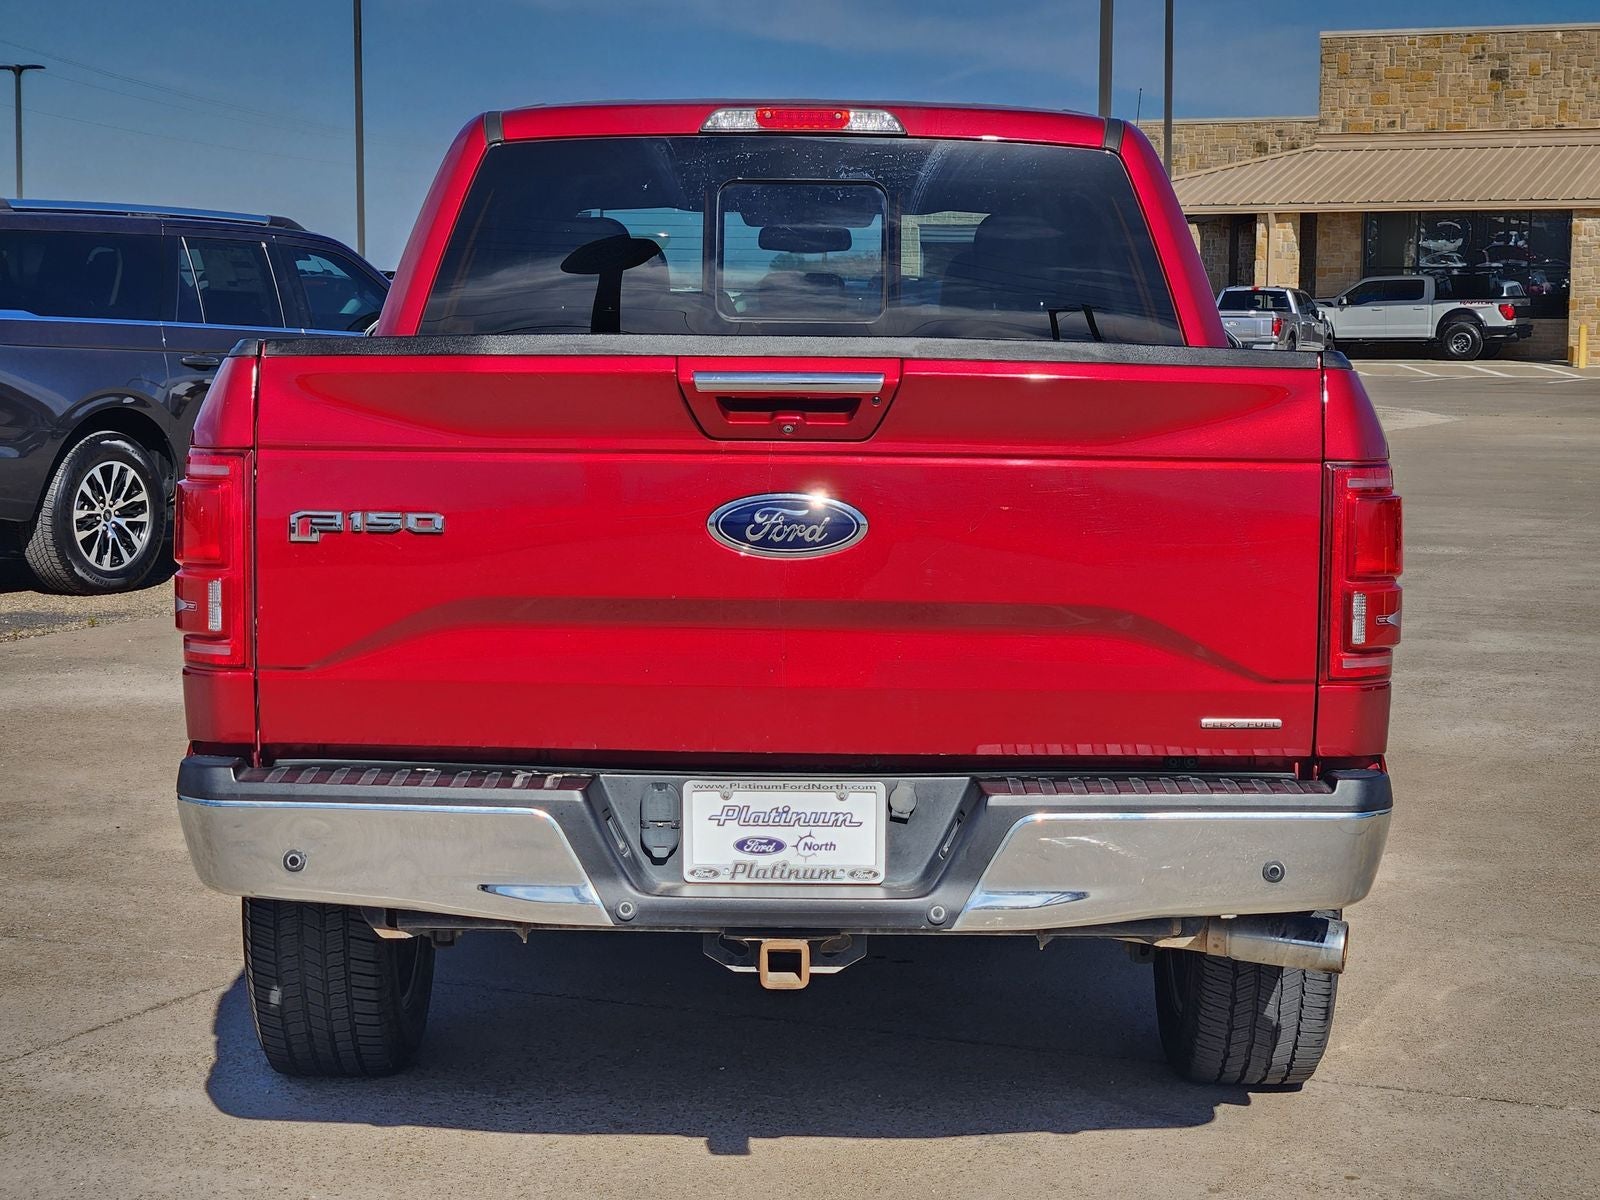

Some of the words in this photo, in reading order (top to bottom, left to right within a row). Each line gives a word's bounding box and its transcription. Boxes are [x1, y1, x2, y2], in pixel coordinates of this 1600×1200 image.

[745, 506, 830, 543] Ford
[1246, 720, 1281, 729] FUEL
[692, 782, 877, 791] www.PlatinumFordNorth.com
[708, 804, 864, 828] Platinum
[743, 838, 777, 853] Ford
[802, 841, 837, 852] North
[730, 861, 844, 881] Platinum
